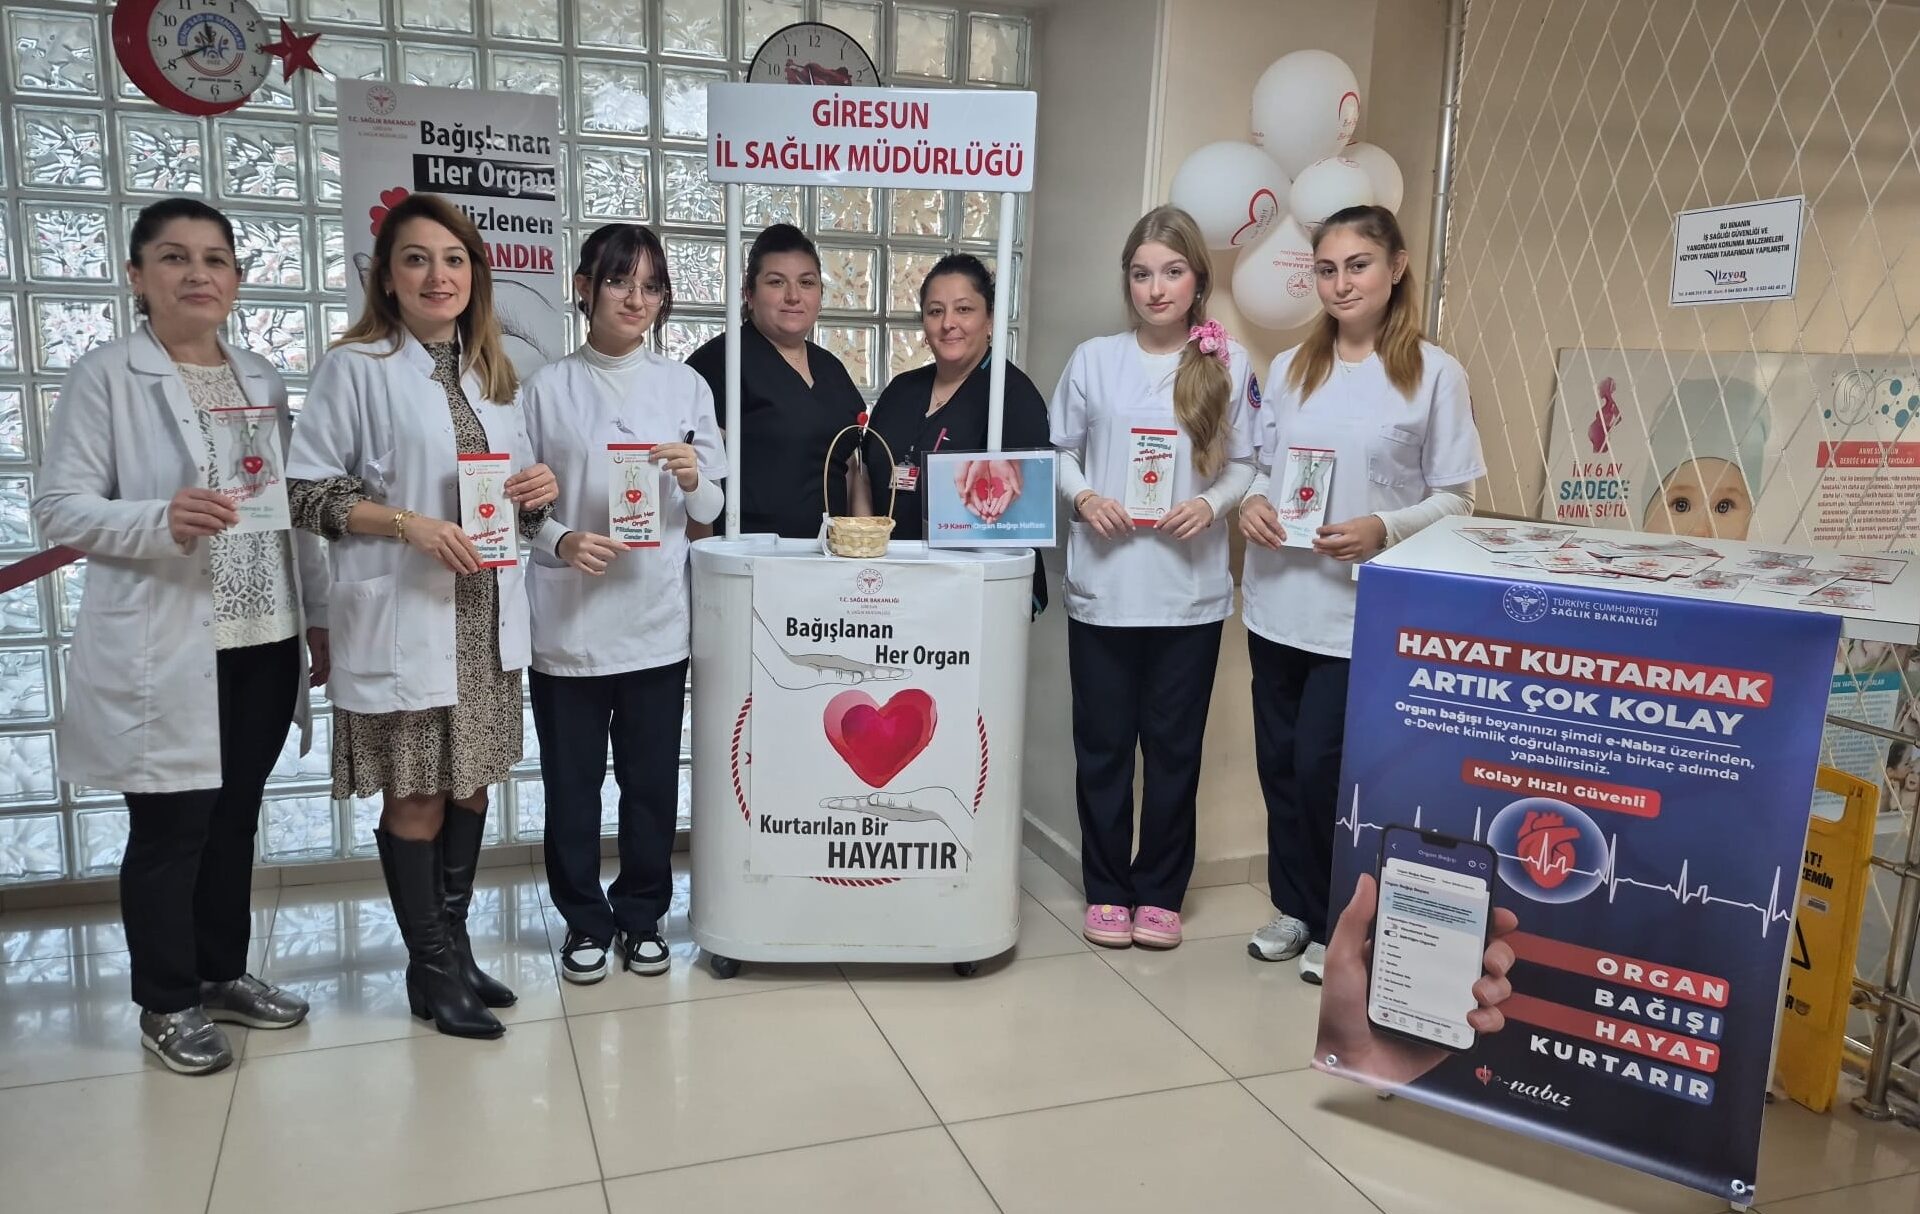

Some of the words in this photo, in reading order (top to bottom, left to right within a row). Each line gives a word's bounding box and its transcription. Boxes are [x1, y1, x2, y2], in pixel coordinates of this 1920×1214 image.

[163, 15, 177, 27] 10
[246, 20, 256, 32] 2
[157, 35, 167, 47] 9
[786, 44, 797, 57] 11
[808, 34, 821, 48] 12
[168, 59, 177, 71] 8
[768, 64, 780, 76] 10
[856, 70, 863, 82] 2
[187, 77, 196, 89] 7
[210, 84, 220, 96] 6
[811, 93, 930, 130] GİRESUN
[715, 133, 738, 168] İL
[745, 136, 840, 172] SAĞLIK
[847, 139, 1024, 178] MÜDÜRLÜĞÜ
[427, 157, 473, 186] Her
[478, 161, 556, 197] Organ
[1699, 250, 1719, 260] YANGIN
[1596, 464, 1602, 477] 6
[469, 530, 497, 542] ağışlanan
[1551, 607, 1591, 620] SAĞLIK
[1595, 612, 1658, 627] BAKANLIĞI
[1553, 598, 1591, 610] TÜRKİYE
[1593, 602, 1659, 617] CUMHURİYETİ
[786, 617, 893, 642] Bağışlanan
[875, 645, 909, 665] Her
[913, 645, 970, 669] Organ
[1399, 632, 1511, 669] HAYAT
[1521, 649, 1767, 703] KURTARMAK
[1409, 667, 1511, 704] ARTIK
[1521, 685, 1605, 717] ÇOK
[1610, 696, 1743, 736] KOLAY
[1395, 701, 1437, 718] Organ
[1440, 706, 1482, 725] bağışı
[1486, 714, 1557, 738] beyanınızı
[1561, 726, 1601, 745] şimdi
[1606, 735, 1666, 755] e-Nabız
[1670, 745, 1755, 769] üzerinden,
[1404, 717, 1460, 736] e-Devlet
[1463, 726, 1506, 743] kimlik
[1509, 734, 1622, 763] doğrulamasıyla
[1627, 751, 1674, 773] birkaç
[1678, 760, 1739, 782] adımda
[1511, 749, 1610, 775] yapabilirsiniz.
[1474, 766, 1522, 787] Kolay
[1527, 776, 1568, 796] Hızlı
[1574, 785, 1646, 809] Güvenli
[760, 814, 856, 836] Kurtarılan
[861, 817, 889, 836] Bir
[827, 842, 957, 870] HAYATTIR
[1596, 957, 1725, 1003] ORGAN
[1595, 989, 1721, 1035] BAĞIŞI
[1596, 1020, 1715, 1067] HAYAT
[1530, 1035, 1710, 1100] KURTARIR
